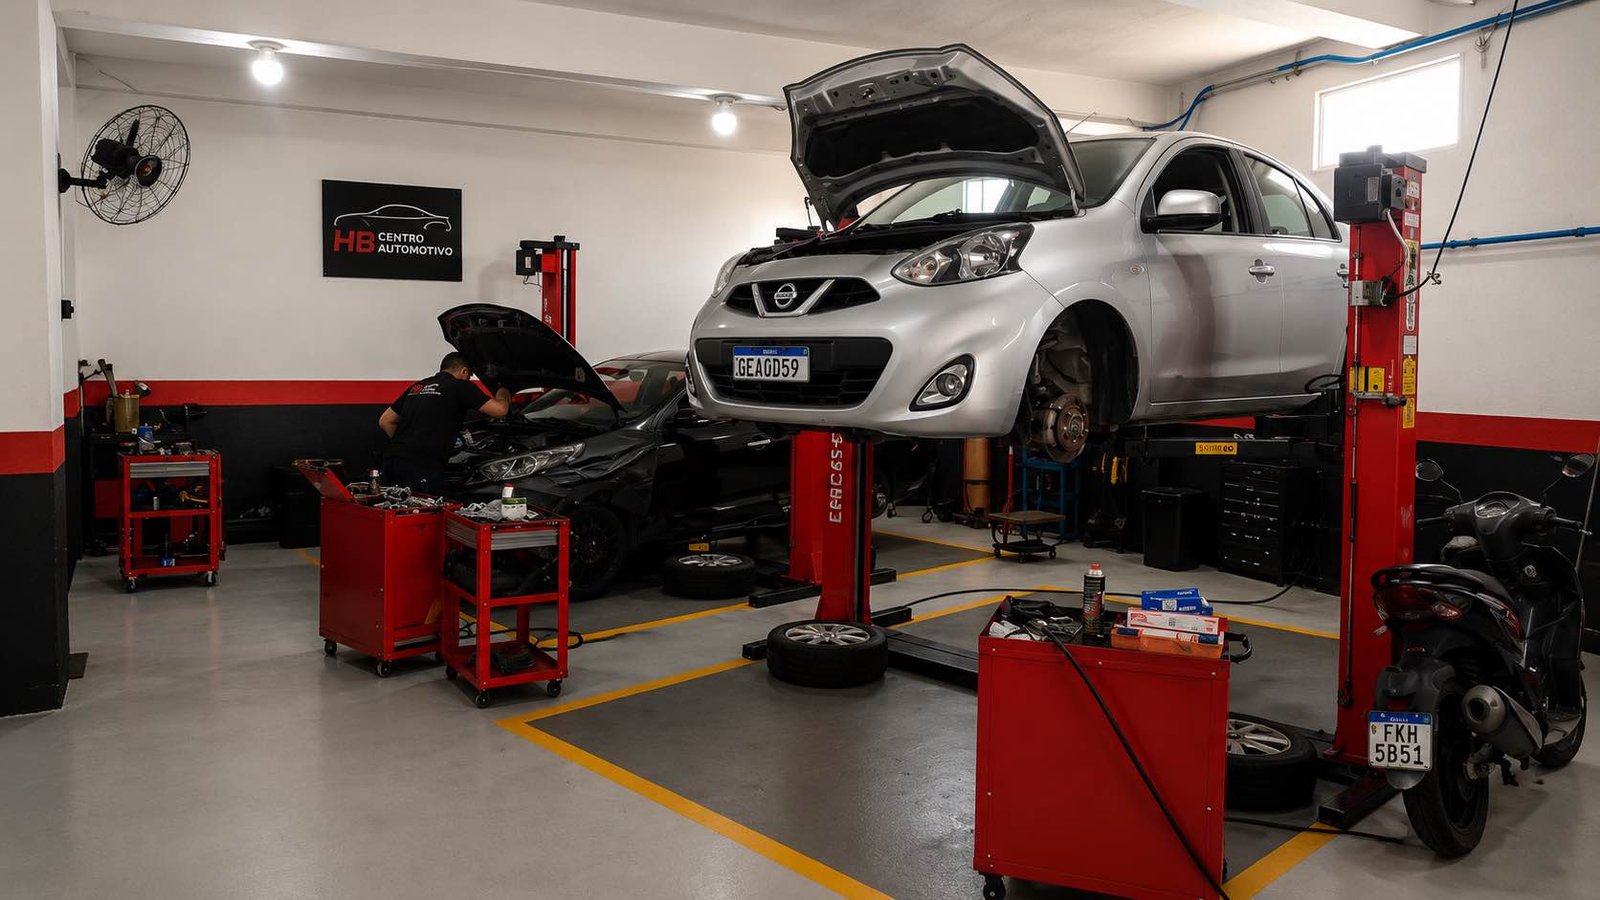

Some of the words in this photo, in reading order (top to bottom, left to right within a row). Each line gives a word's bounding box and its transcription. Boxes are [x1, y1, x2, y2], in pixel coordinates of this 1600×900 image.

[333, 229, 376, 253] HB
[378, 232, 424, 243] CENTRO
[378, 244, 453, 256] AUTOMOTIVO
[1383, 724, 1418, 744] FKH
[1375, 743, 1424, 765] 5B51
